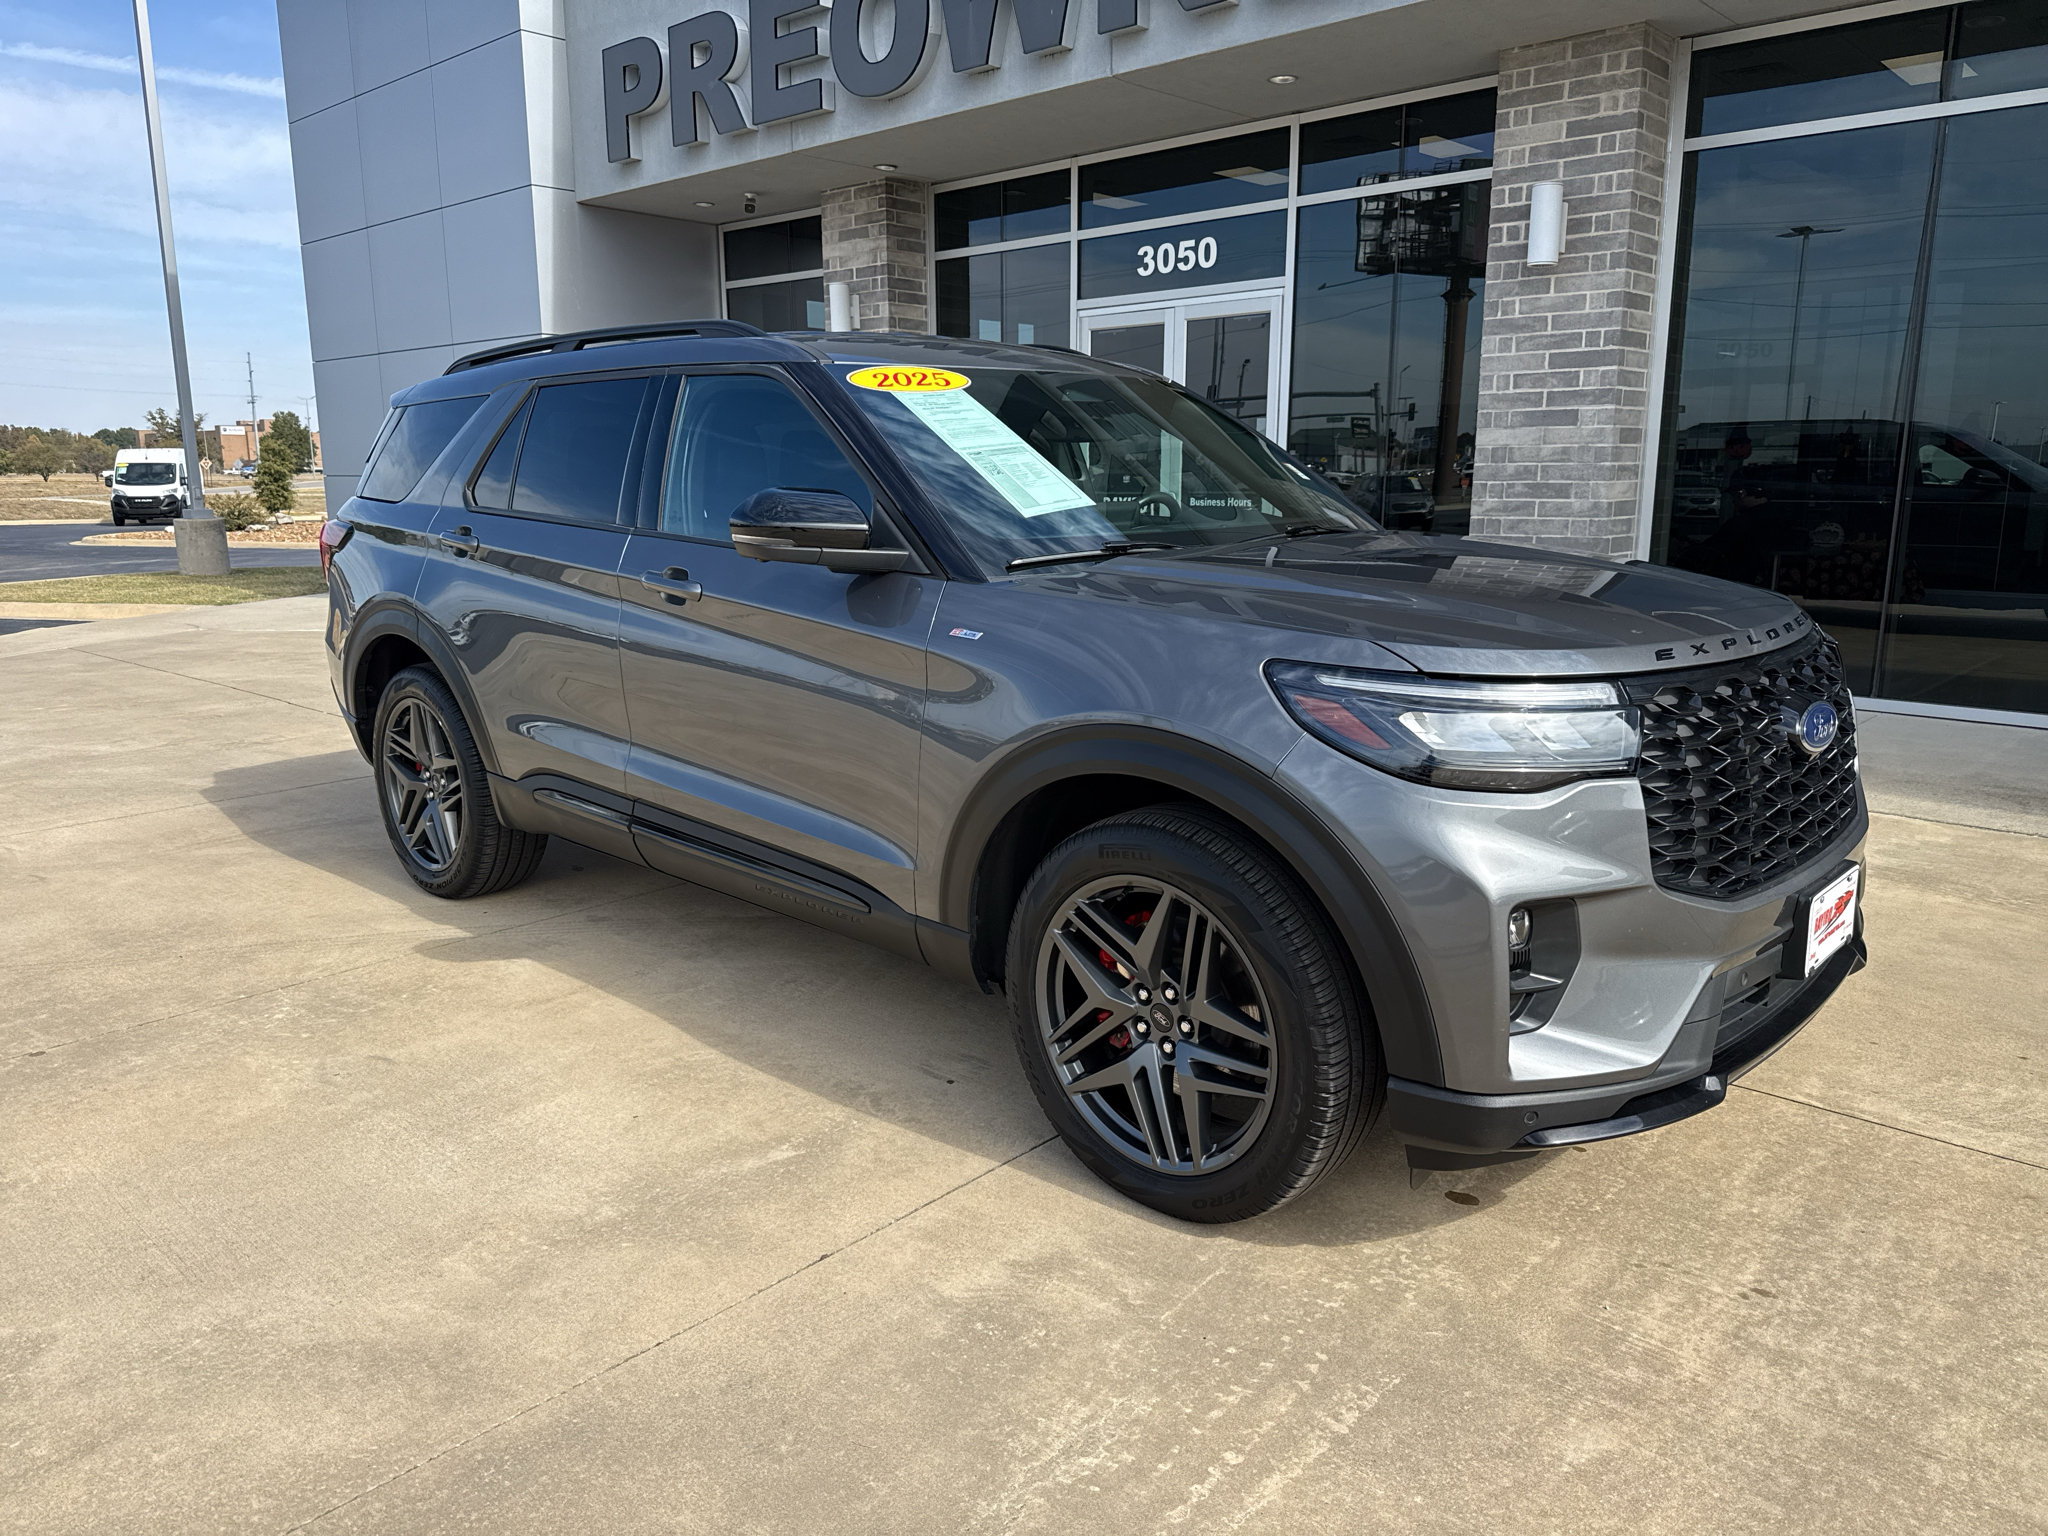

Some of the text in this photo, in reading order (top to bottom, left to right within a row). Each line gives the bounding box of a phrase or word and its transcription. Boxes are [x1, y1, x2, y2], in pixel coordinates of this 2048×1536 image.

[602, 0, 1238, 163] PREO
[1136, 236, 1218, 277] 3050
[872, 371, 951, 388] 2025
[1189, 497, 1252, 508] Business Hours
[1098, 843, 1152, 861] PIRELLI
[755, 884, 864, 925] EXPLORER
[1190, 1178, 1252, 1211] ZERO
